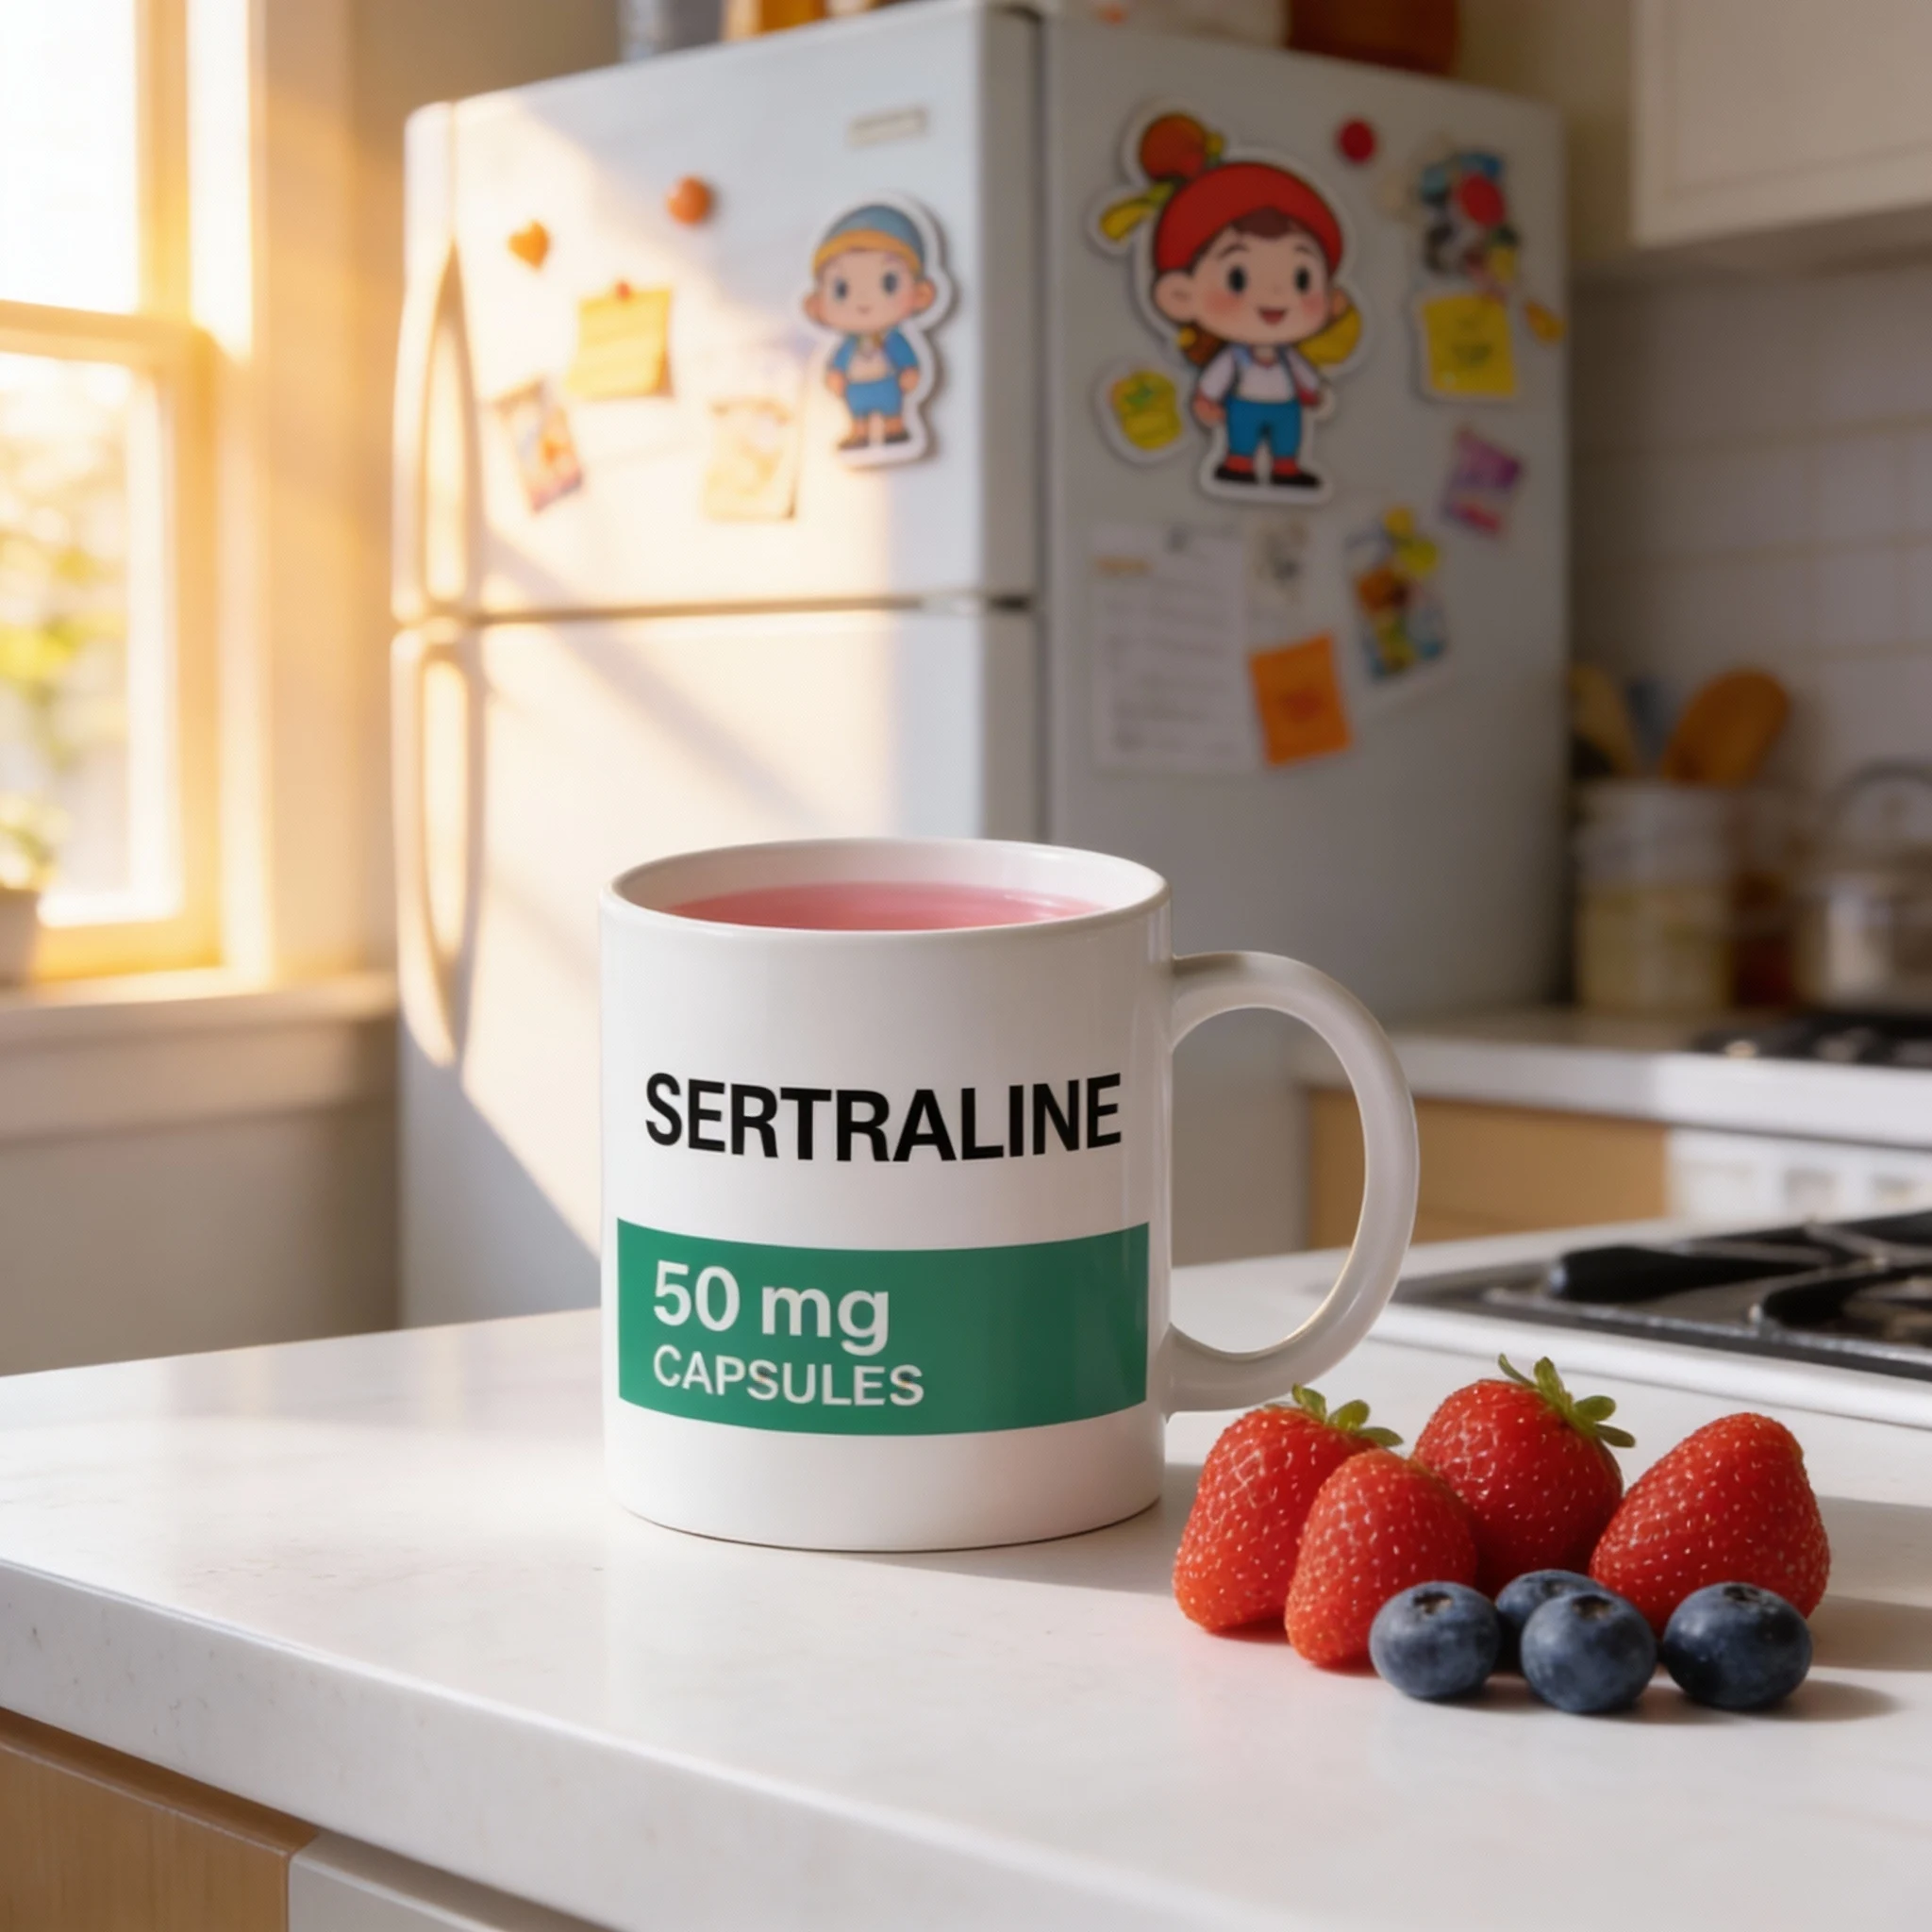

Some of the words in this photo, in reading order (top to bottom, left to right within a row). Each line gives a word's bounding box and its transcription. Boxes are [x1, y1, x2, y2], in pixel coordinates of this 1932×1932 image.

[645, 1072, 1122, 1162] SERTRALINE
[653, 1259, 741, 1332] 50
[760, 1286, 890, 1357] mg
[653, 1344, 924, 1407] CAPSULES
